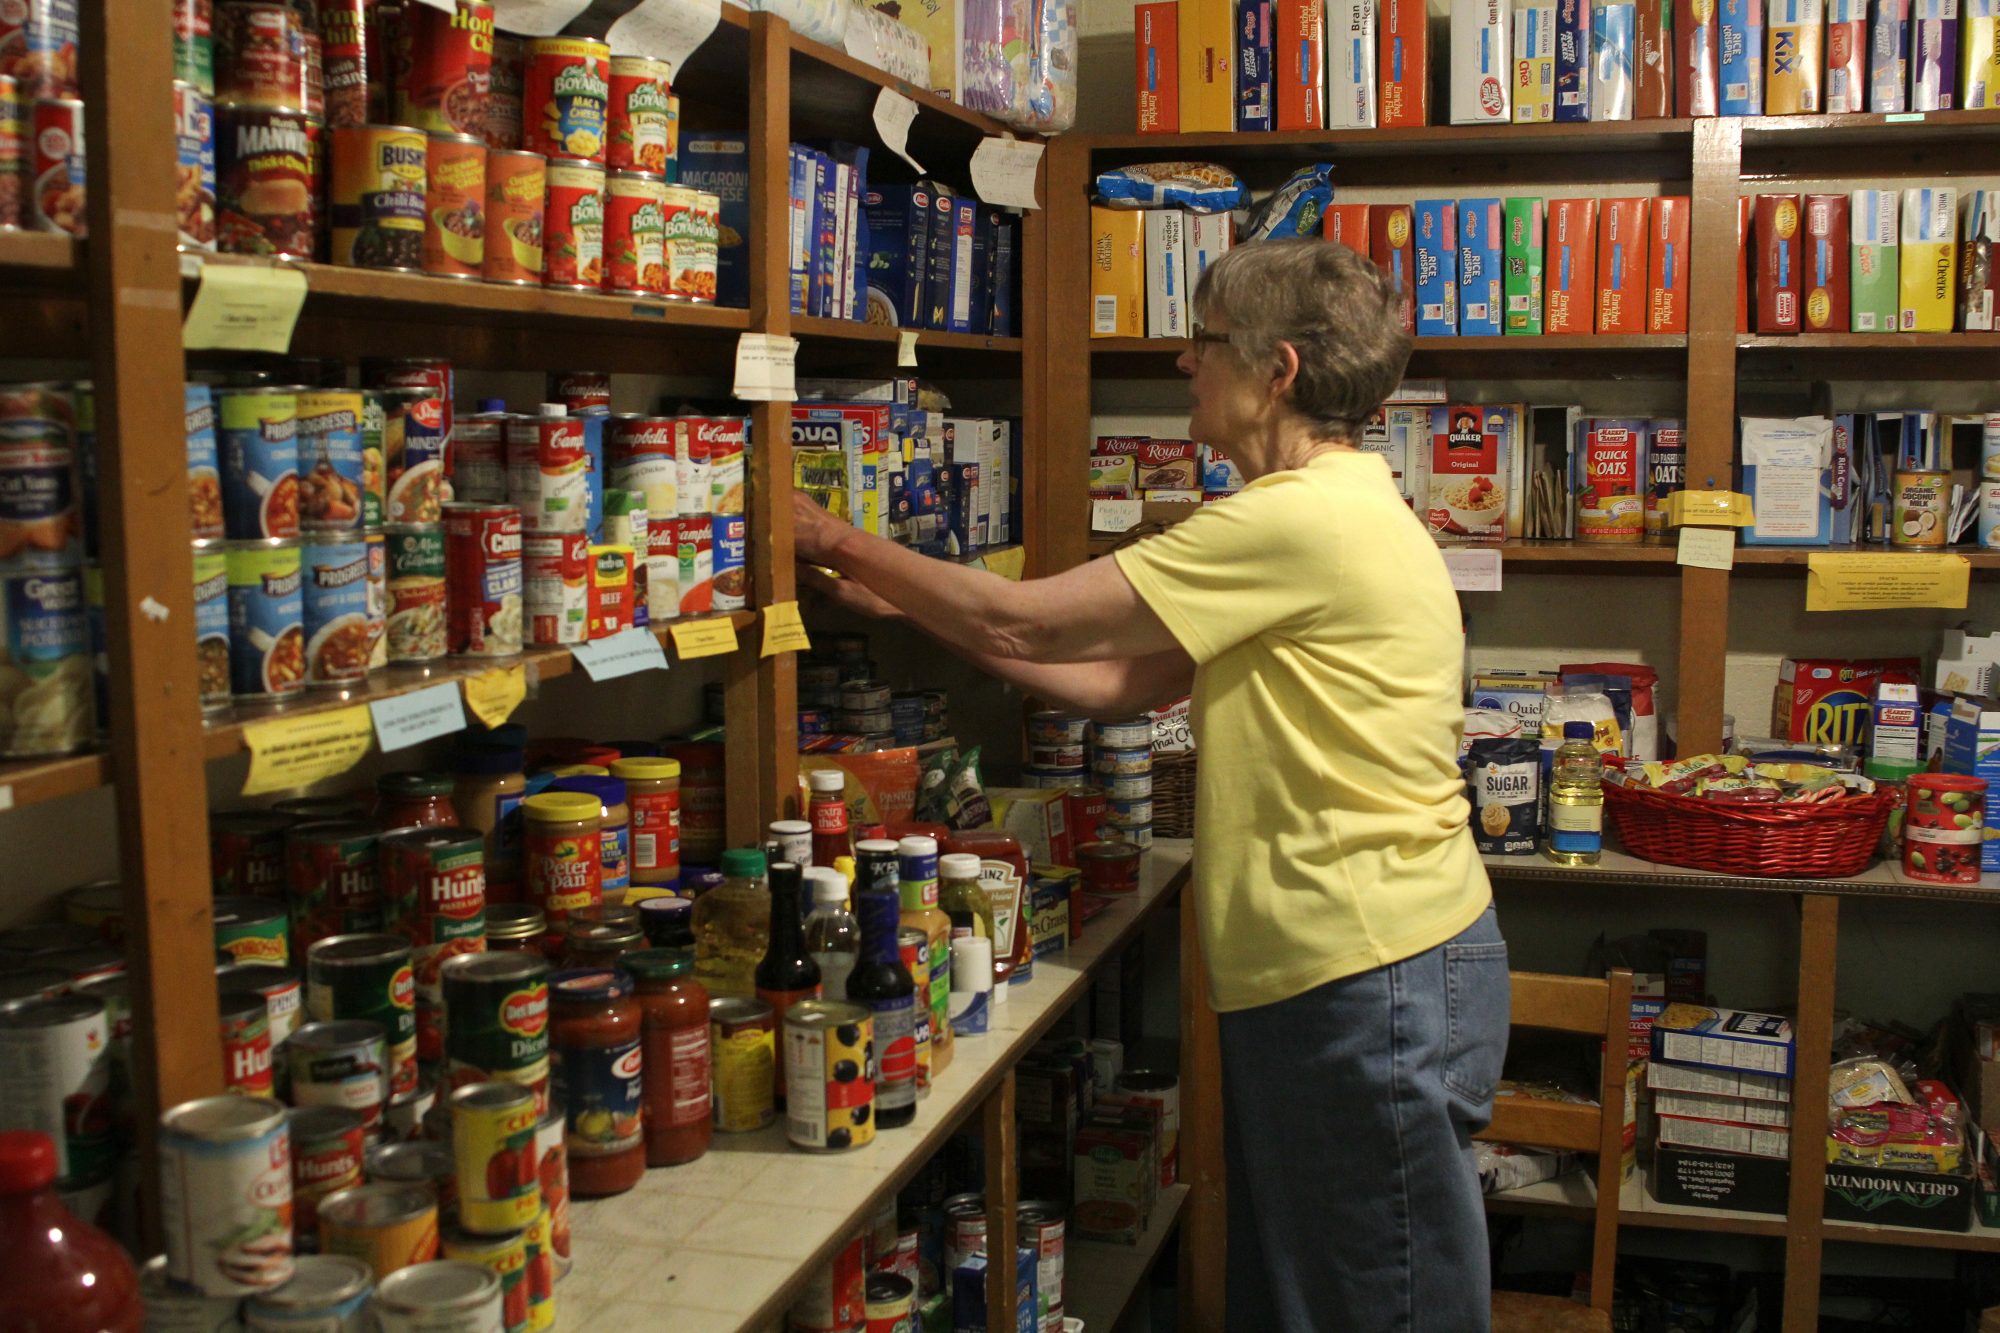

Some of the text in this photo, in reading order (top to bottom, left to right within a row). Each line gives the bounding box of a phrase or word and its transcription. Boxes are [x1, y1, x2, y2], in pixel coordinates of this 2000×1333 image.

[1300, 5, 1308, 36] Enriched
[1352, 5, 1360, 31] Bran
[1488, 9, 1497, 25] Corn
[1560, 33, 1569, 61] FLAKES
[1566, 31, 1576, 64] FROSTED
[1722, 25, 1732, 65] KRISPIES
[1732, 32, 1742, 55] RICE
[1774, 32, 1795, 75] Kix
[1831, 27, 1843, 57] Chex
[1248, 46, 1257, 78] FROSTED
[1518, 60, 1530, 88] Chex
[573, 96, 593, 106] MAC
[1385, 81, 1393, 124] Bran Flakes
[1394, 86, 1402, 118] Enriched
[570, 109, 601, 120] CHEESE
[1881, 194, 1889, 244] WHOLE GRAIN
[1103, 233, 1112, 272] SHREDDED
[1418, 247, 1428, 286] KRISPIES
[1428, 255, 1437, 278] RICE
[1462, 247, 1472, 286] KRISPIES
[1471, 255, 1481, 277] RICE
[1936, 258, 1951, 300] Cheerios
[1551, 290, 1560, 332] Bran Flakes
[1560, 295, 1569, 327] Enriched
[1602, 289, 1611, 331] Bran Flakes
[1611, 294, 1621, 326] Enriched
[1654, 288, 1663, 330] Bran Flakes
[1663, 293, 1673, 325] Enriched
[1359, 444, 1396, 453] ORGANIC
[1449, 433, 1481, 442] QUAKER
[1147, 444, 1185, 461] Royal
[1594, 450, 1629, 461] QUICK
[1451, 461, 1479, 469] Original
[1596, 461, 1628, 475] OATS
[1655, 465, 1686, 483] OATS
[1838, 457, 1846, 475] Rich
[600, 592, 623, 605] BEEF
[1839, 668, 1854, 680] RITZ
[1508, 700, 1544, 717] Quick
[1884, 708, 1913, 716] MARKET
[1515, 717, 1542, 728] rea
[1809, 702, 1872, 745] RITZ
[1486, 776, 1528, 792] SUGAR
[817, 807, 843, 818] extra
[818, 816, 842, 829] thick
[542, 858, 590, 876] Peter
[1631, 1003, 1645, 1013] Size
[1889, 1151, 1934, 1160] Maruchan
[1905, 1180, 1959, 1197] GREEN
